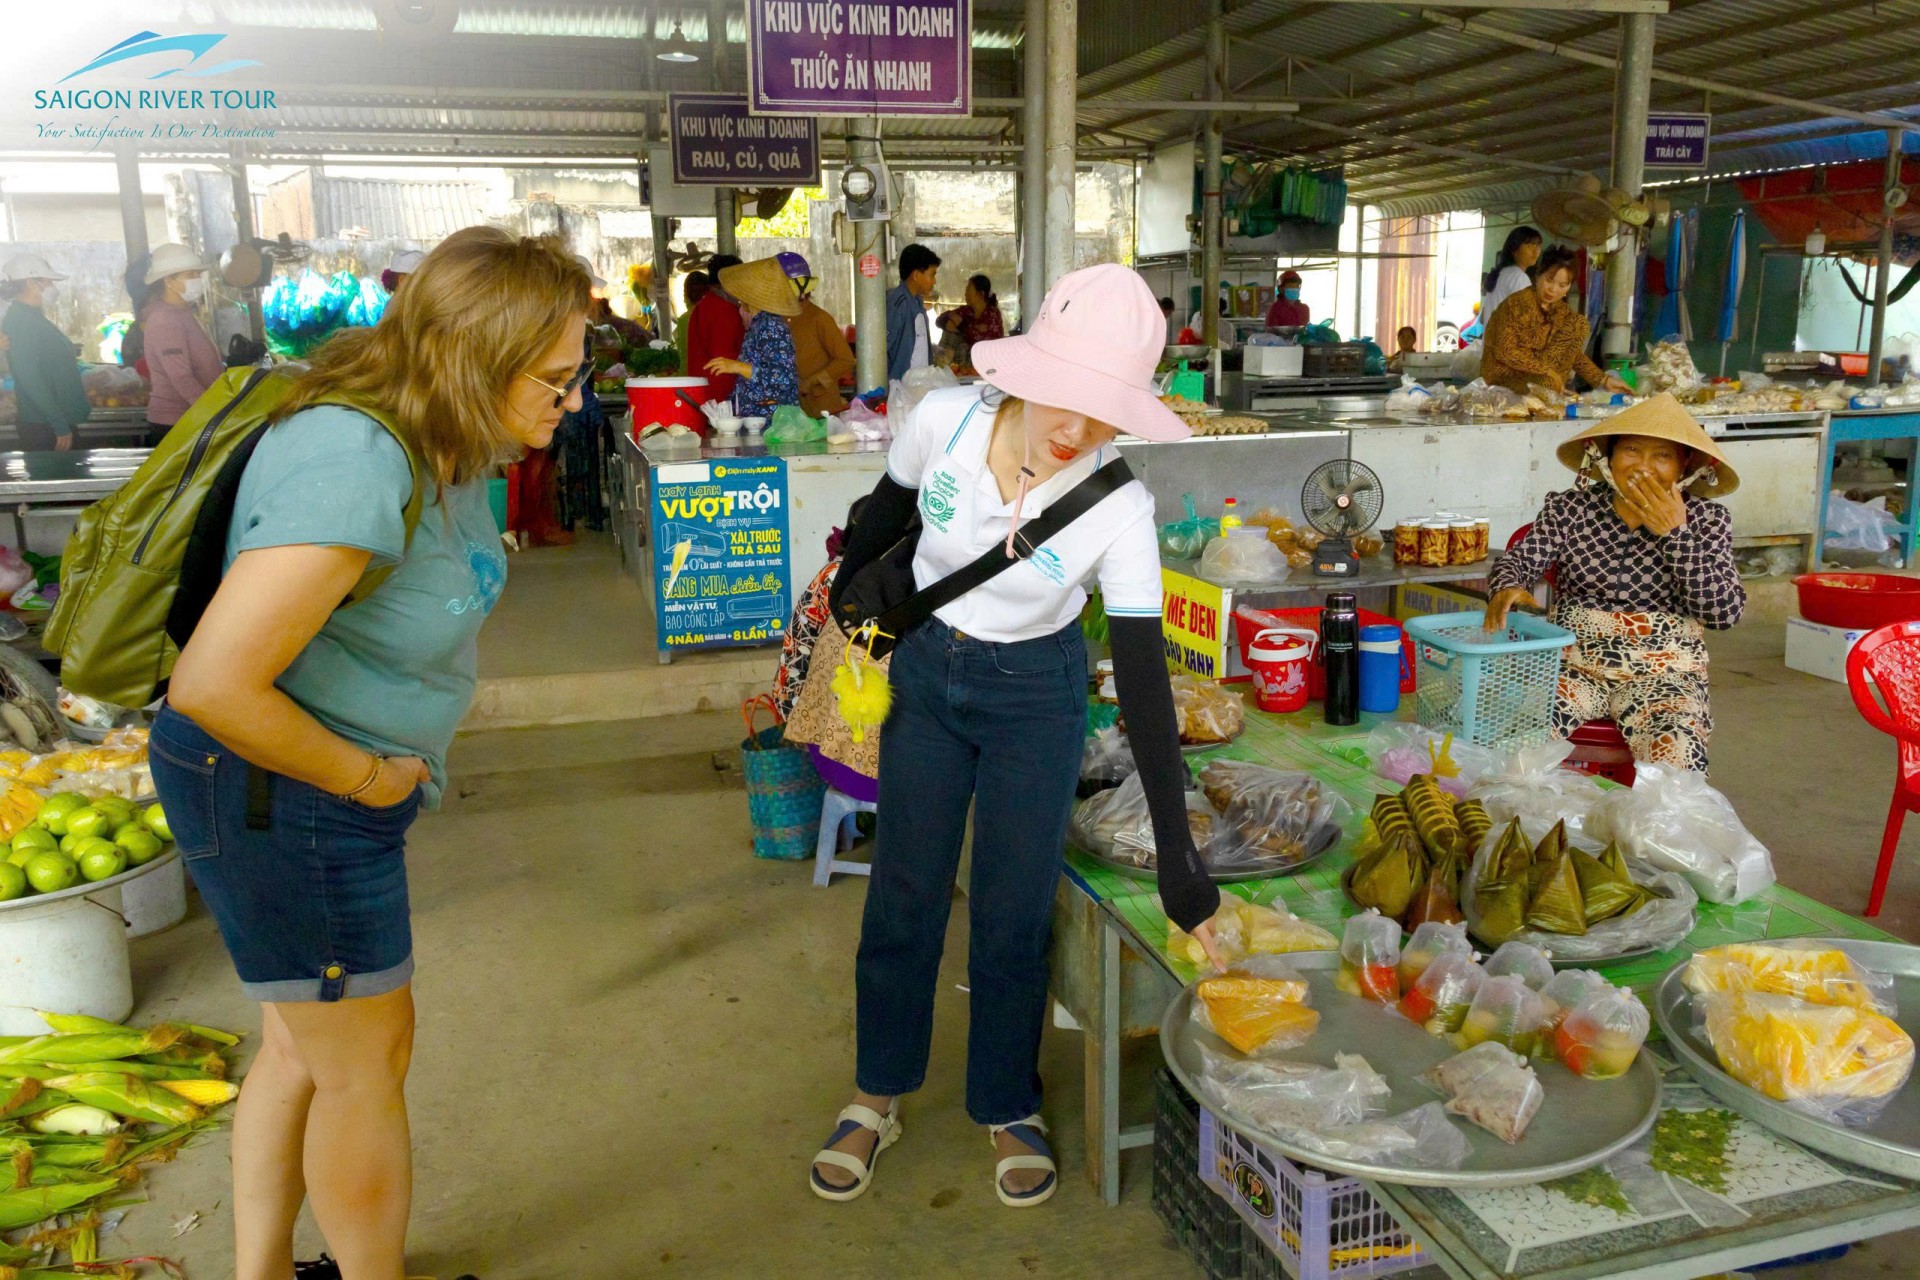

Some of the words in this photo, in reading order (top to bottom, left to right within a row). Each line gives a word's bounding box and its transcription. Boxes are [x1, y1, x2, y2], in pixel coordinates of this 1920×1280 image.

[765, 1, 802, 33] KHU
[807, 0, 843, 40] VỰC
[849, 4, 890, 36] KINH
[896, 6, 954, 37] DOANH
[791, 50, 839, 90] THỨC
[844, 53, 868, 90] ĂN
[874, 60, 931, 91] NHANH
[681, 116, 706, 137] KHU
[709, 114, 734, 141] VỰC
[737, 117, 765, 138] KINH
[769, 119, 808, 139] DOANH
[1671, 125, 1685, 138] KINH
[1685, 125, 1705, 138] DOANH
[692, 151, 730, 171] RAU,
[735, 145, 763, 172] CỦ,
[768, 146, 801, 172] QUẢ
[1656, 145, 1674, 158] TRÁI
[1675, 145, 1692, 158] CÂY
[932, 480, 954, 499] Choice
[660, 497, 733, 523] VƯỢT
[723, 482, 780, 515] TRỘI
[731, 529, 748, 544] XÀI
[749, 528, 781, 543] TRƯỚC
[757, 544, 781, 554] SAU
[701, 575, 729, 597] MUA
[686, 602, 704, 612] VẬT
[665, 615, 683, 629] BAO
[684, 612, 708, 629] CÔNG
[1189, 600, 1217, 642] ĐEN
[1183, 645, 1215, 679] XANH
